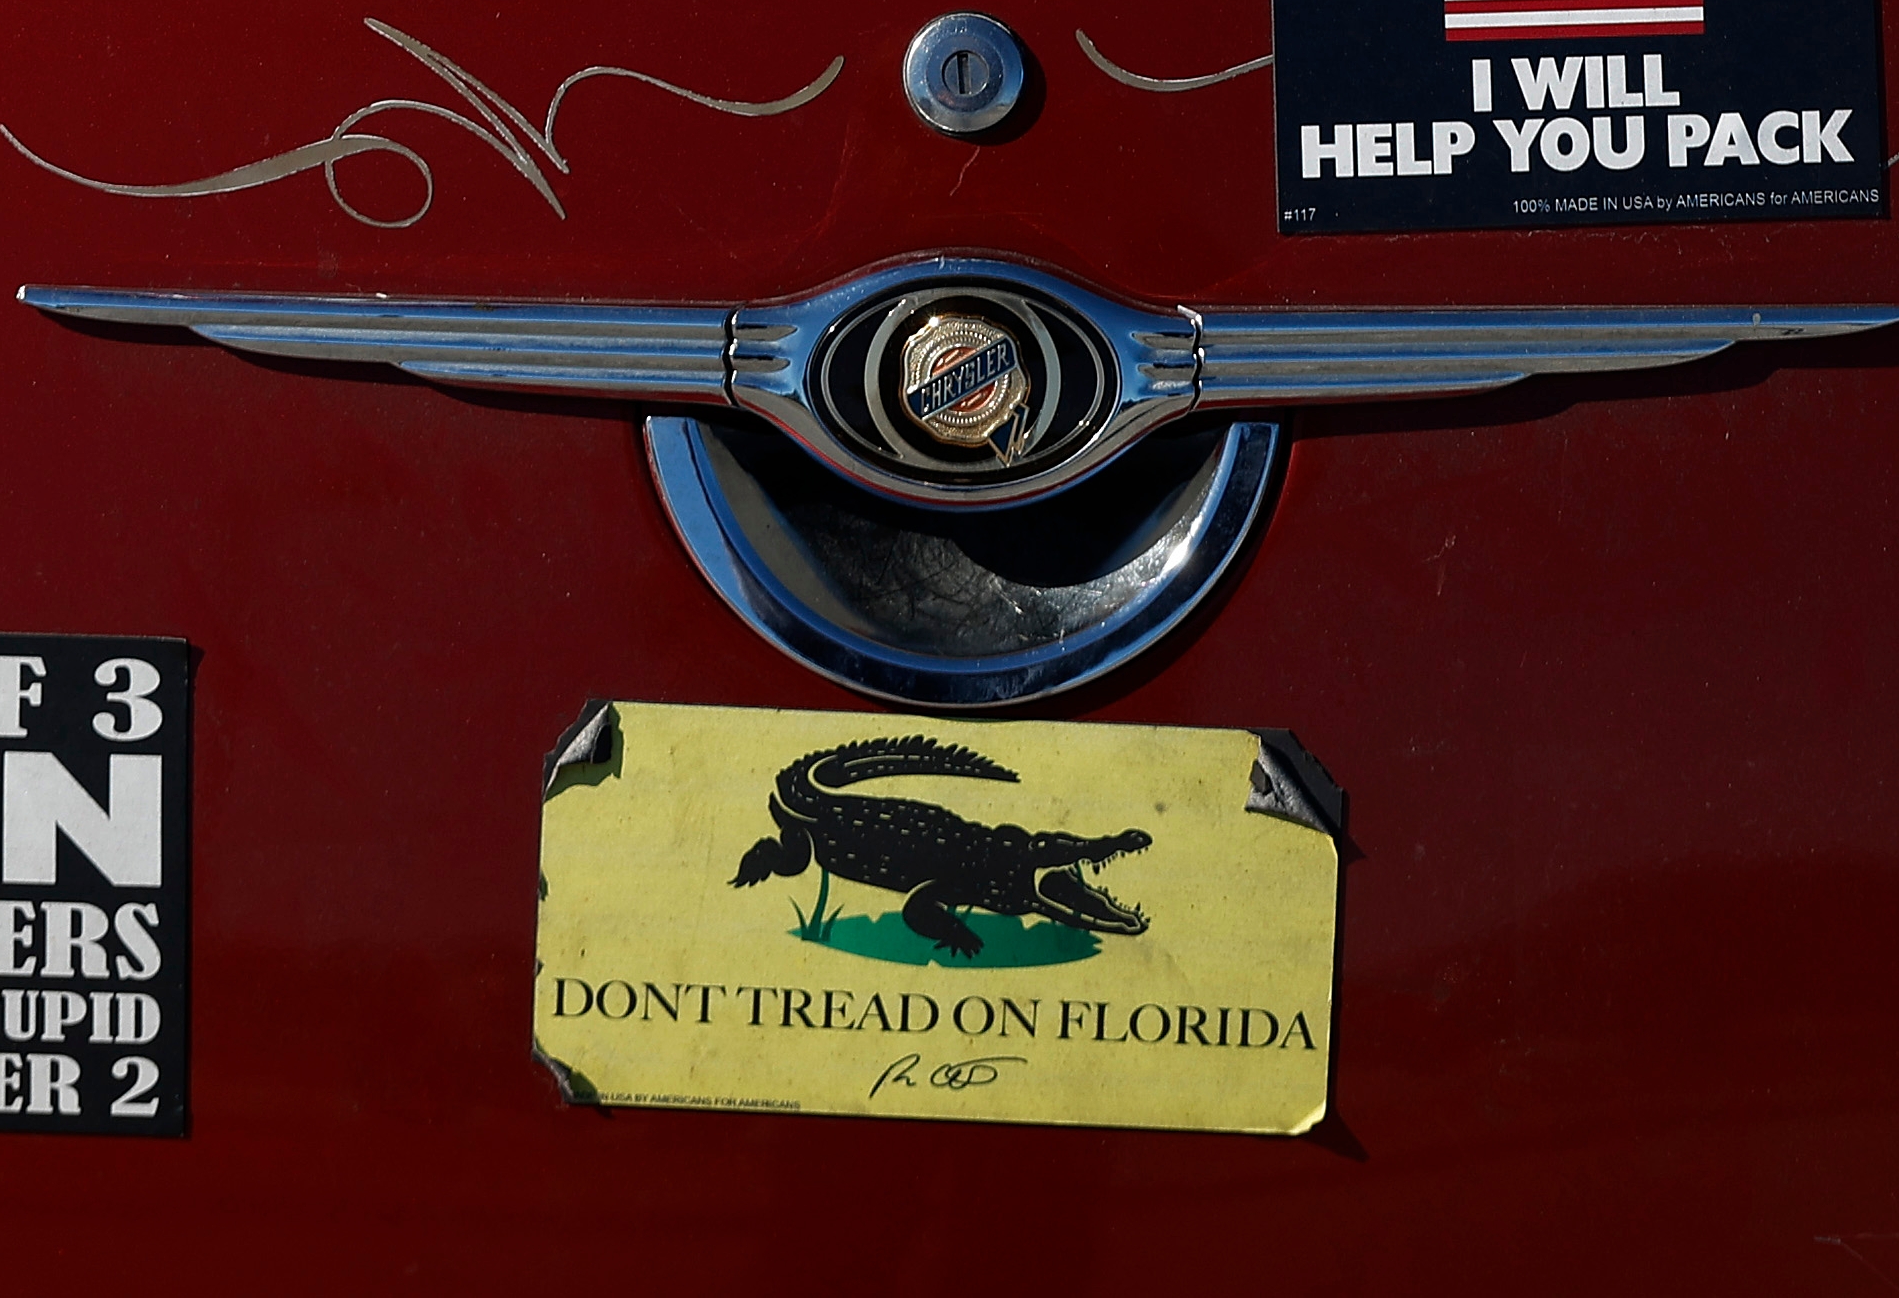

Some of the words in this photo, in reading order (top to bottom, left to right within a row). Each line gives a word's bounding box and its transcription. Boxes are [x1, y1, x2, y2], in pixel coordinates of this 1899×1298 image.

[1472, 59, 1492, 112] I
[1511, 54, 1680, 110] WILL
[1301, 122, 1475, 178] HELP
[1493, 116, 1645, 172] YOU
[1668, 110, 1854, 167] PACK
[1284, 208, 1315, 221] #117
[1514, 199, 1550, 213] 100%
[1556, 197, 1598, 211] MADE
[1604, 197, 1617, 210] IN
[1623, 196, 1653, 209] USA
[1657, 196, 1672, 211] by
[1676, 193, 1765, 207] AMERICANS
[1770, 192, 1787, 205] for
[1791, 189, 1879, 204] AMERICANS
[919, 343, 1011, 416] CHRYSLER
[93, 658, 162, 741] 3
[554, 978, 726, 1023] DONT
[737, 987, 939, 1032] TREAD
[953, 997, 1040, 1037] ON
[1058, 1001, 1316, 1050] FLORIDA
[111, 1057, 159, 1116] 2
